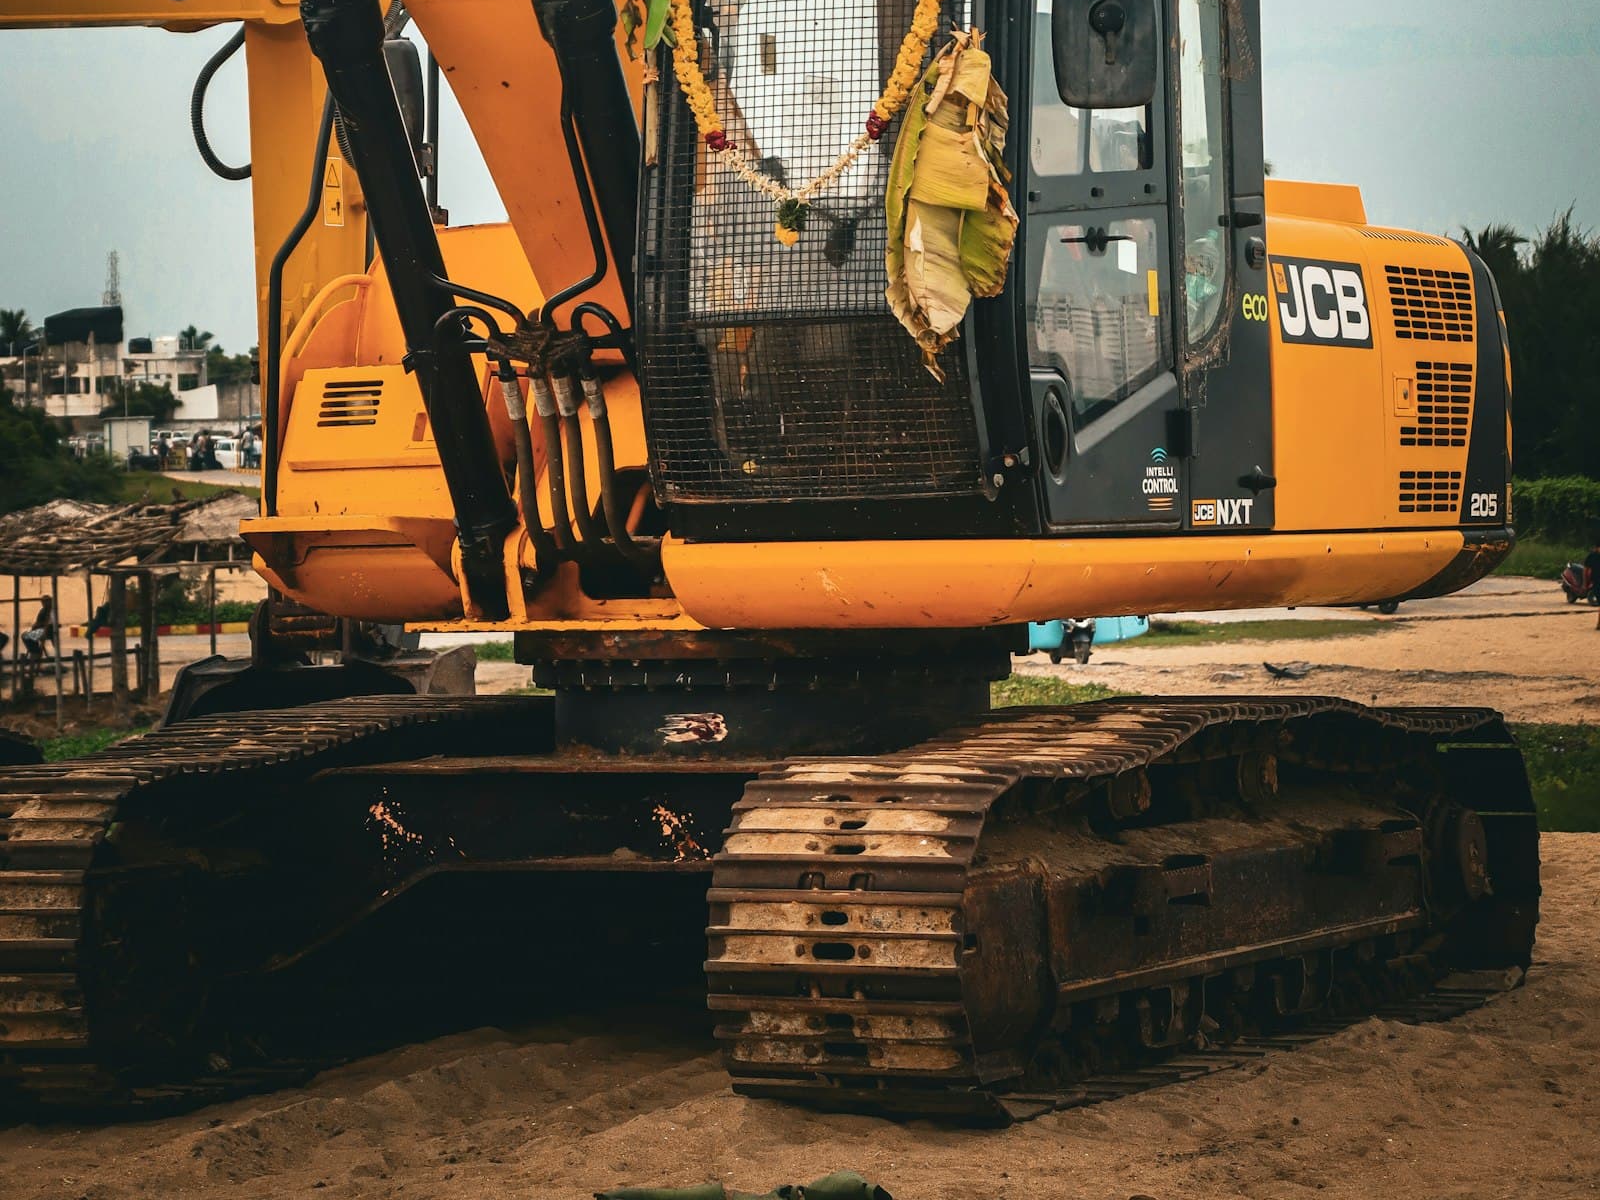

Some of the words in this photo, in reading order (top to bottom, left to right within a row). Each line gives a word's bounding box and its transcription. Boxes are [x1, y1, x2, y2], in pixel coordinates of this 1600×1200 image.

[1242, 293, 1268, 321] eco
[1279, 264, 1370, 340] JCB
[1146, 466, 1174, 477] INTELLI
[1142, 478, 1179, 494] CONTROL
[1194, 504, 1215, 521] JCB
[1216, 498, 1253, 525] NXT
[1470, 493, 1498, 517] 205
